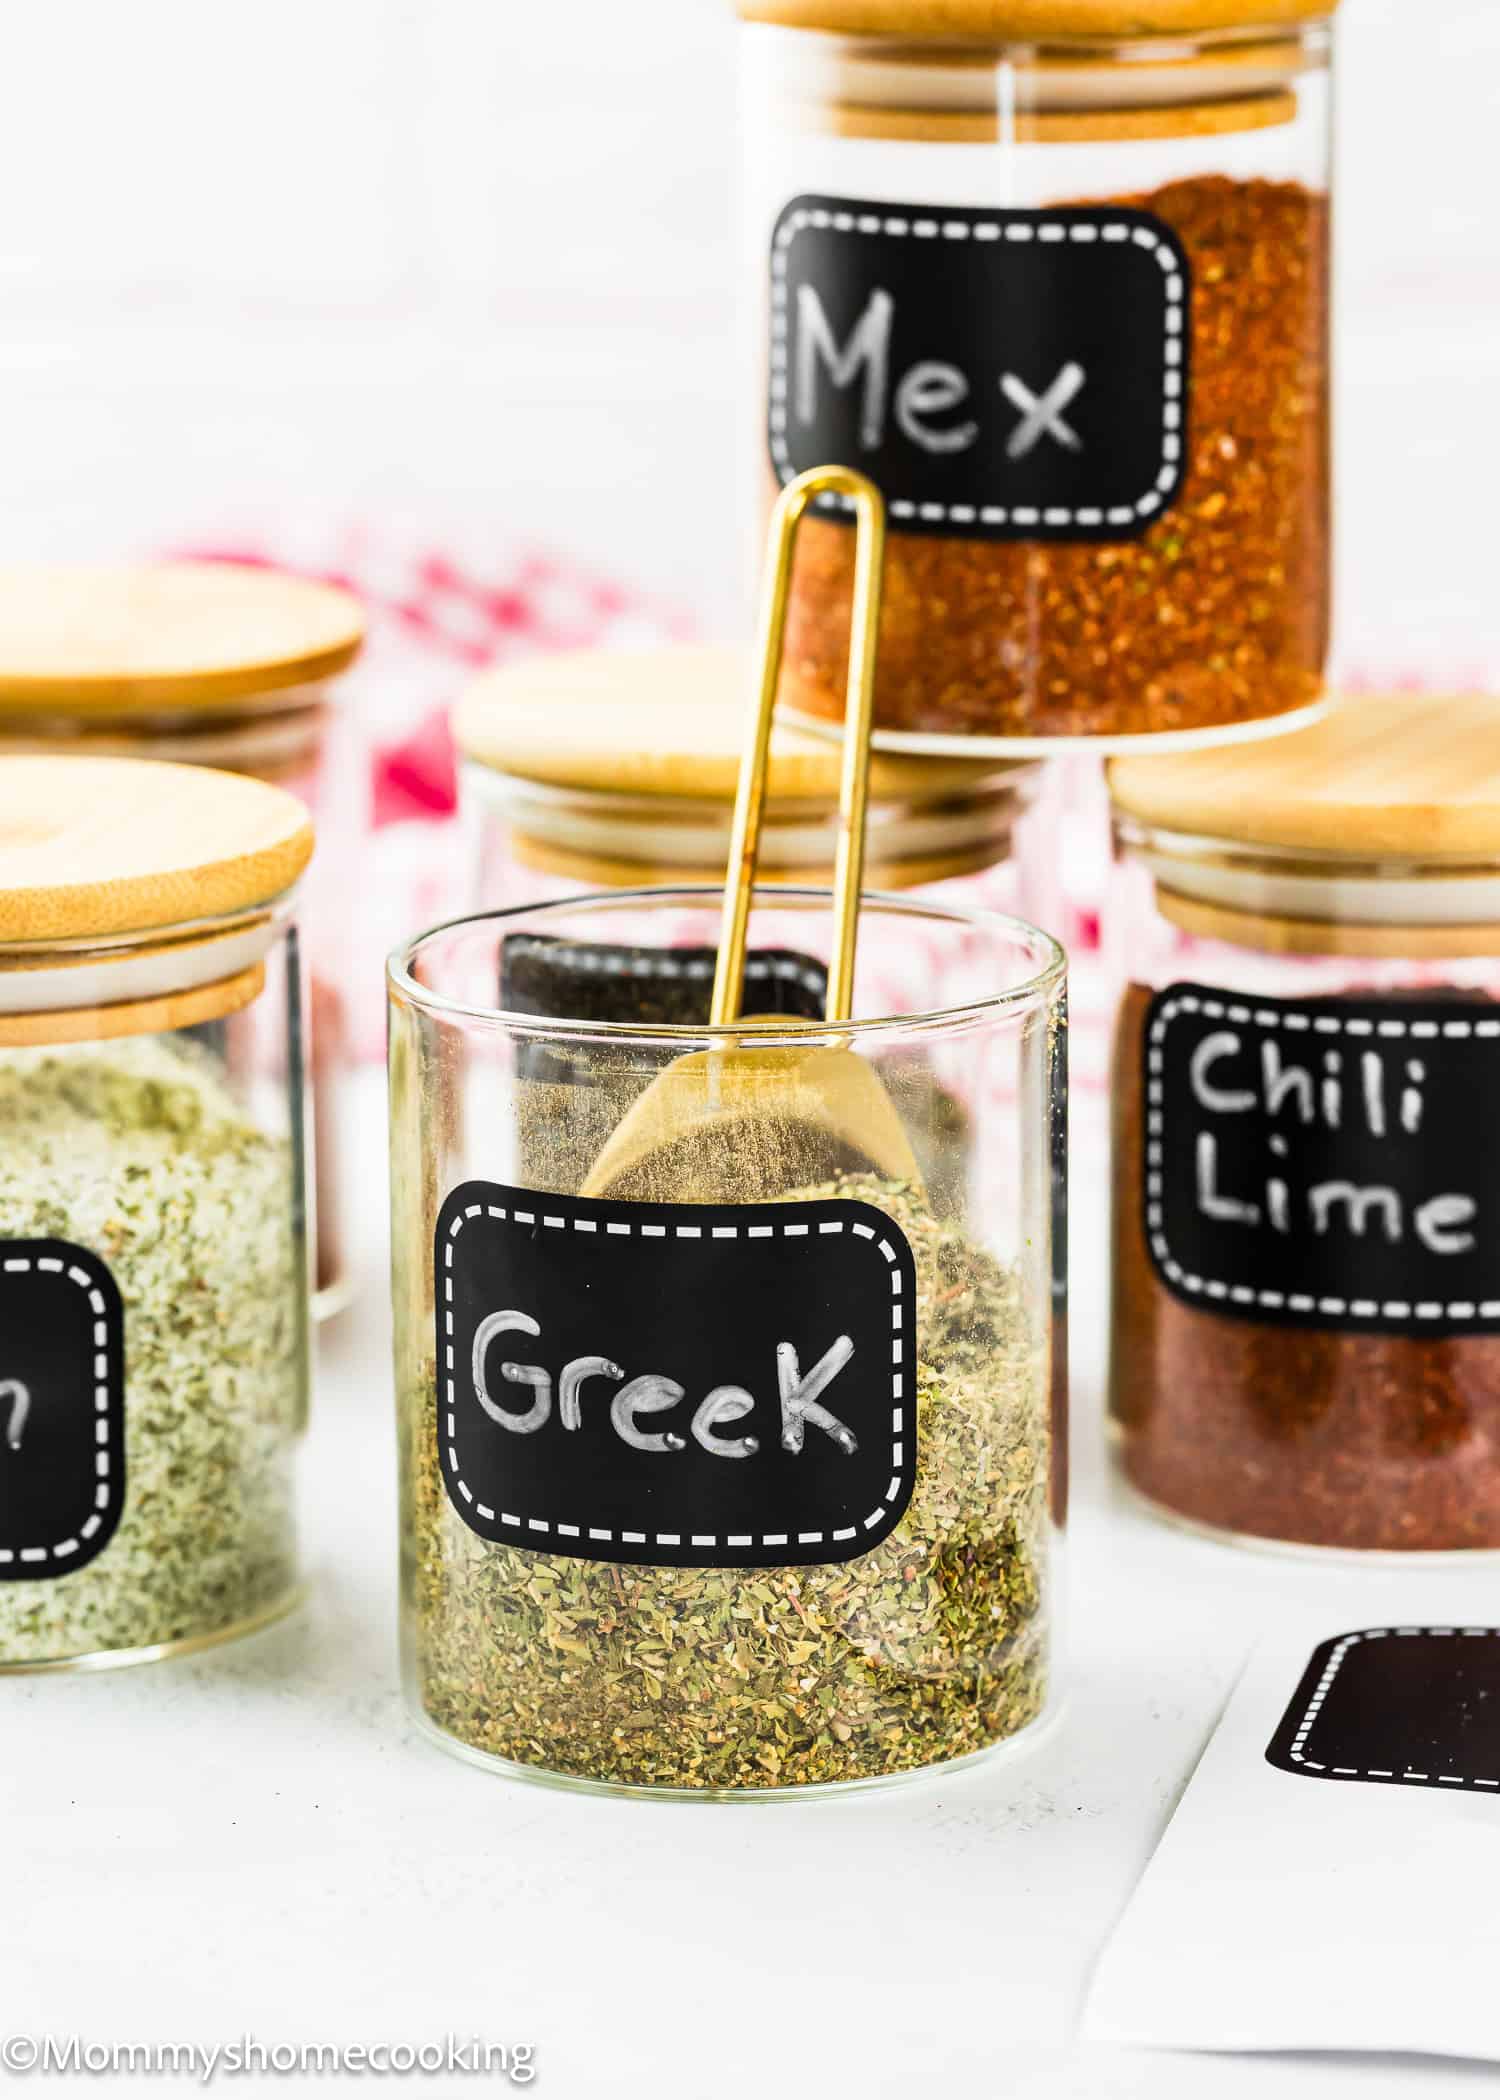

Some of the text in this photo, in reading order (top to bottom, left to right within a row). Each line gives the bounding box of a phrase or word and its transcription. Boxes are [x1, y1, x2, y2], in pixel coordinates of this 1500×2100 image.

[795, 284, 1086, 460] Mex
[1189, 1030, 1426, 1138] Chili
[1195, 1131, 1477, 1255] Lime
